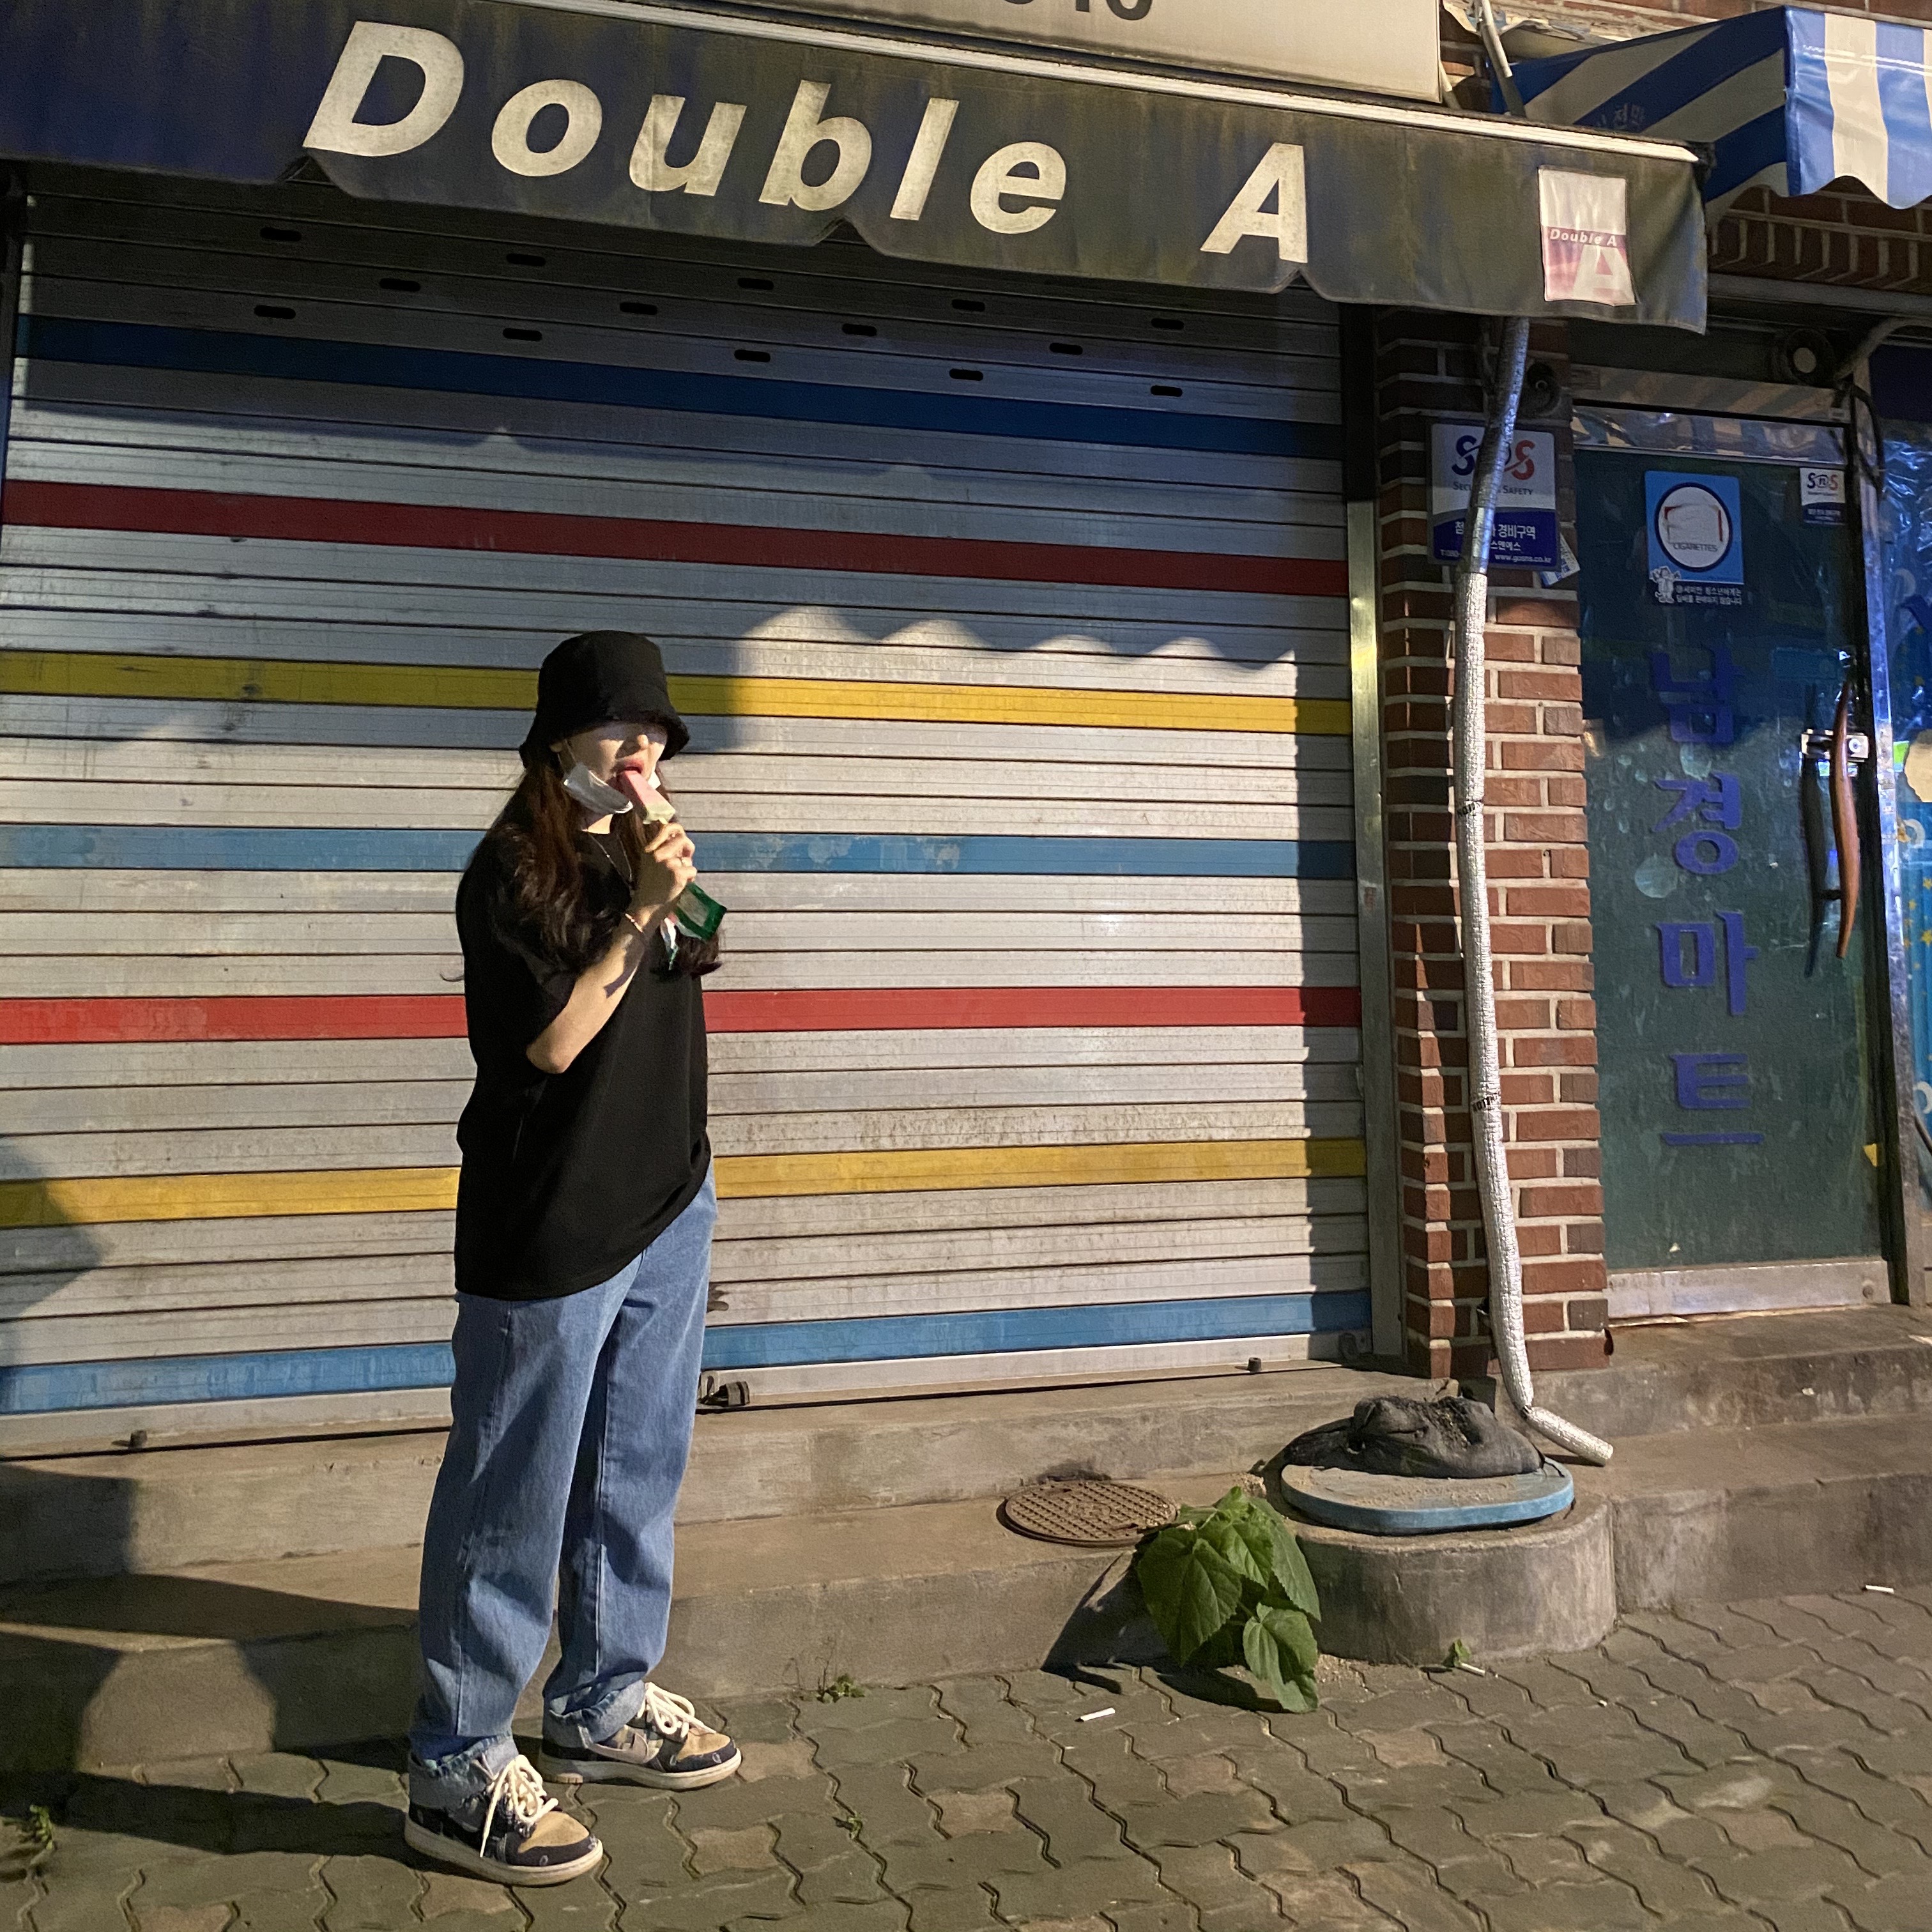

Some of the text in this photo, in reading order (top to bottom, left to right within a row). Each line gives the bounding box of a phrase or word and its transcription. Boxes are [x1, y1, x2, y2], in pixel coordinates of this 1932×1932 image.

[302, 20, 1309, 264] Double A
[1549, 228, 1617, 247] Double A
[1503, 485, 1534, 496] SAFETY
[1498, 524, 1536, 540] 경비구역
